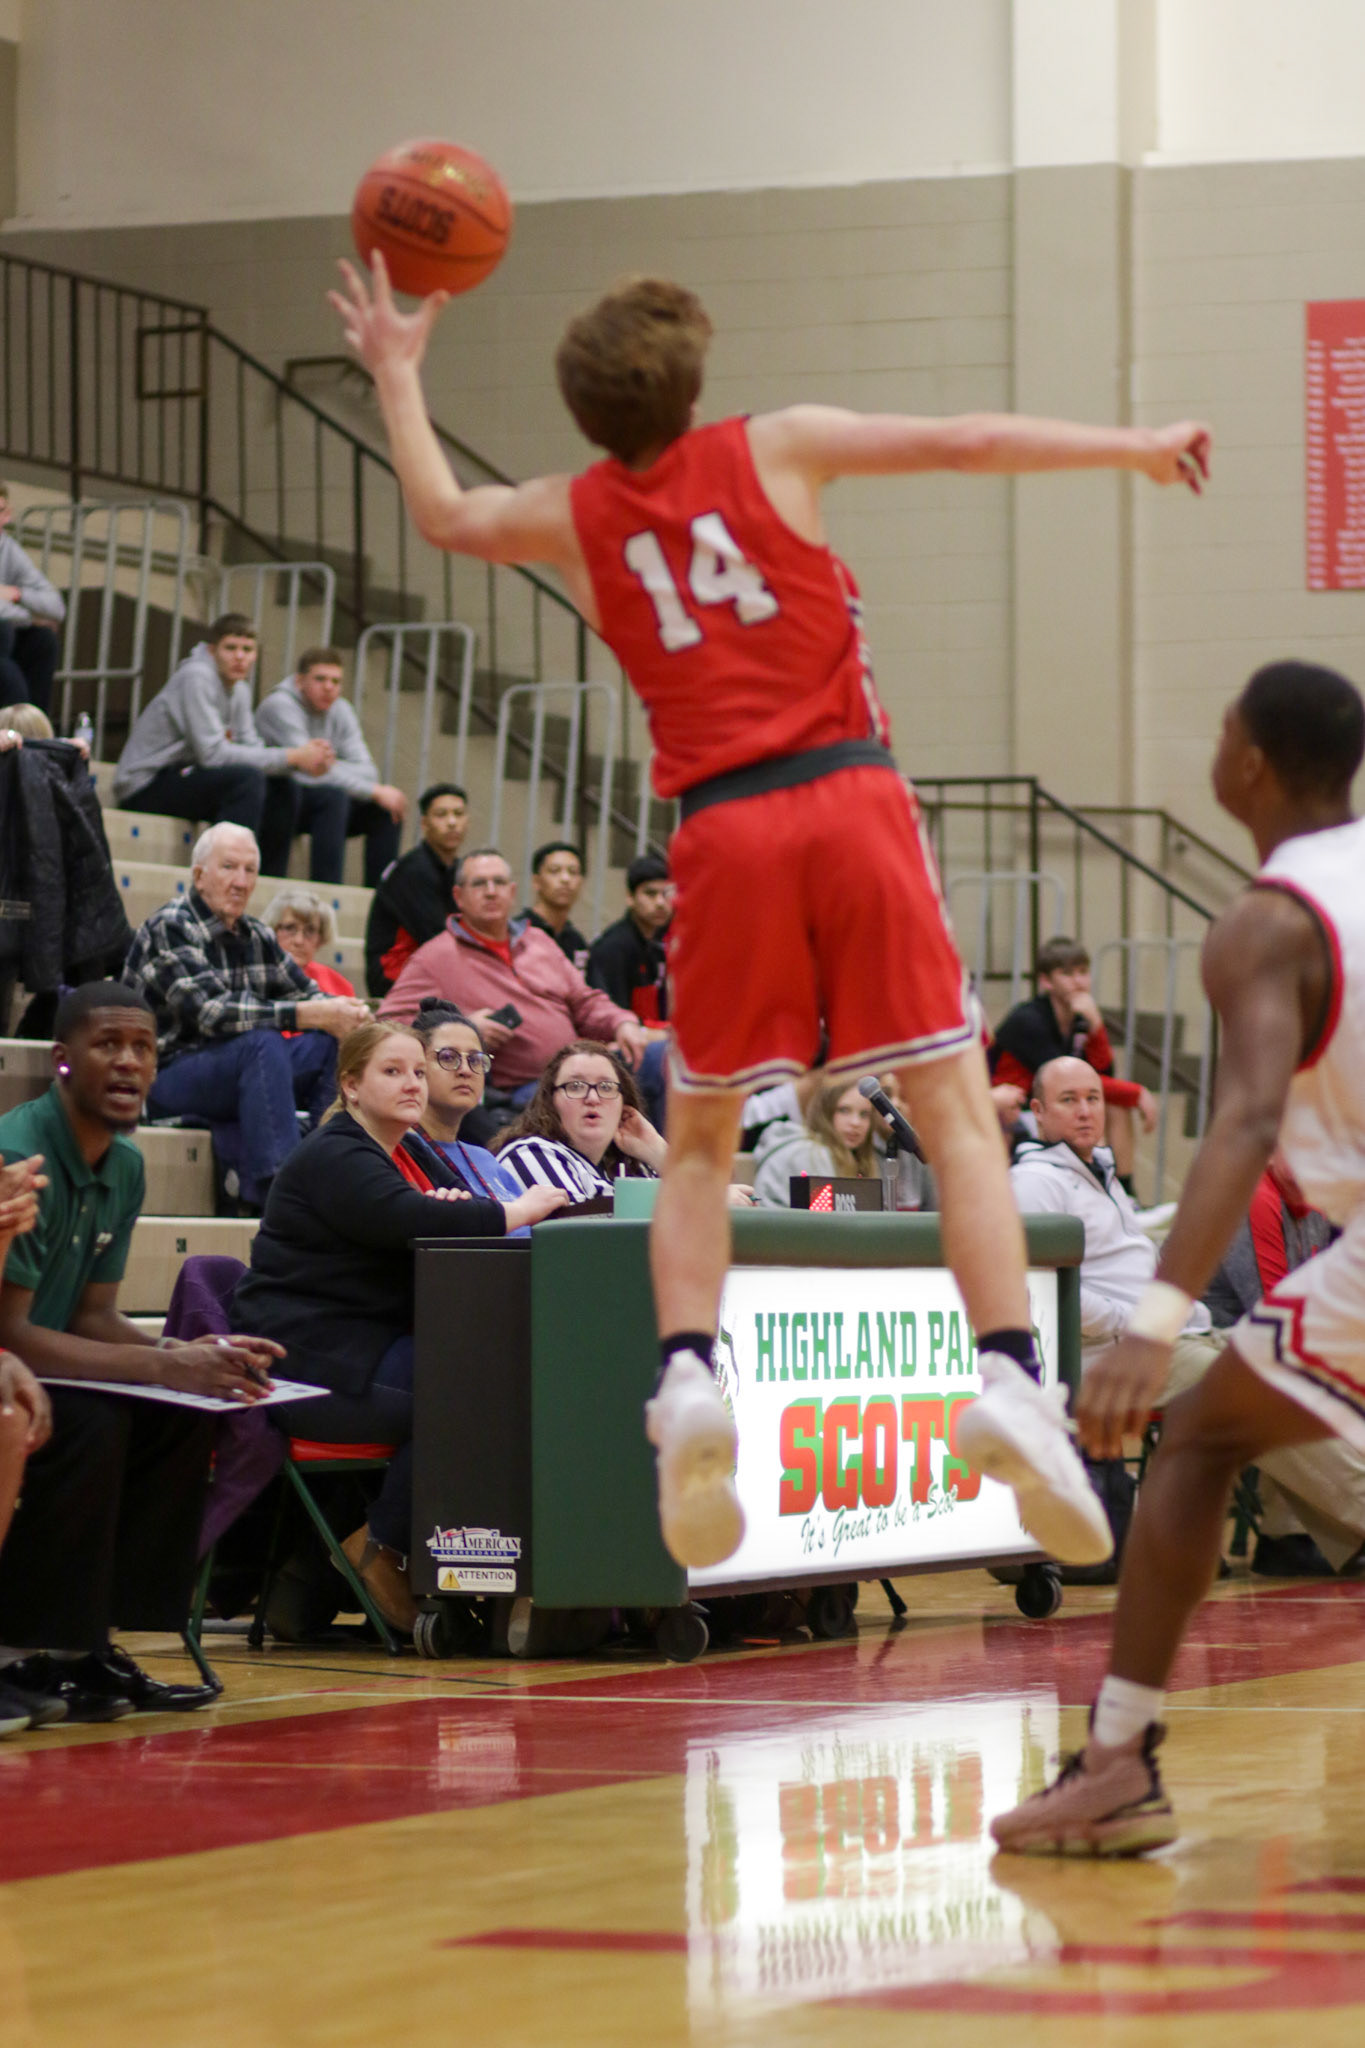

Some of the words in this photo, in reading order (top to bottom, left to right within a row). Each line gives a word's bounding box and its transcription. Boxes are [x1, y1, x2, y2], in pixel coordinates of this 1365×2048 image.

[624, 510, 780, 653] 14
[755, 1311, 917, 1382] HIGHLAND
[801, 1514, 825, 1554] It's
[832, 1505, 871, 1557] Great
[875, 1504, 889, 1533] to
[894, 1494, 908, 1527] be
[912, 1501, 921, 1522] a
[457, 1570, 513, 1580] ATTENTION
